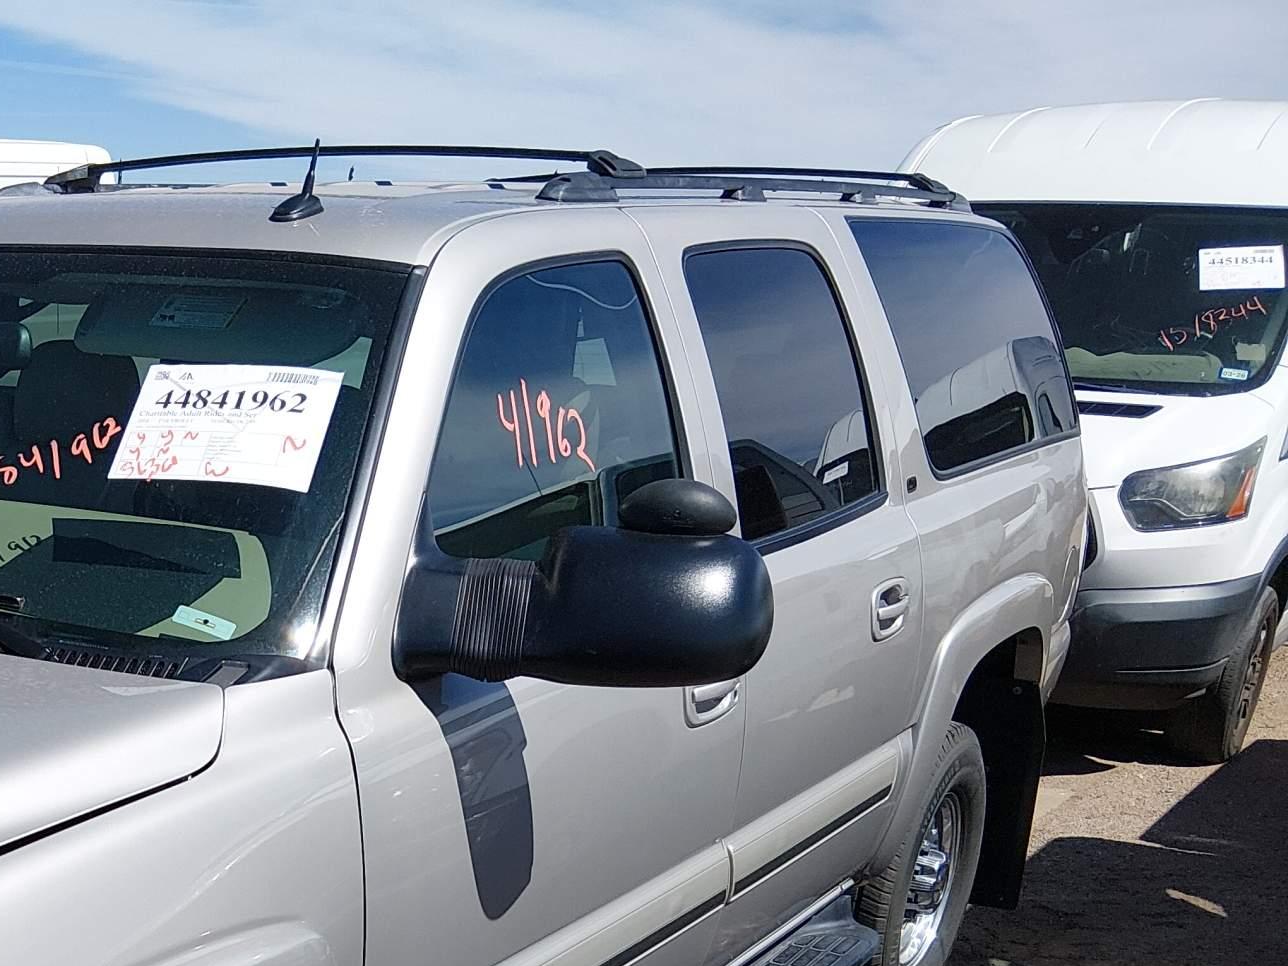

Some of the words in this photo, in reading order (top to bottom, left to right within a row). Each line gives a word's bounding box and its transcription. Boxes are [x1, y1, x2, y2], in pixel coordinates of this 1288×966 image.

[1208, 256, 1274, 265] 44518344
[155, 389, 307, 413] 44841962
[497, 378, 595, 472] 41962
